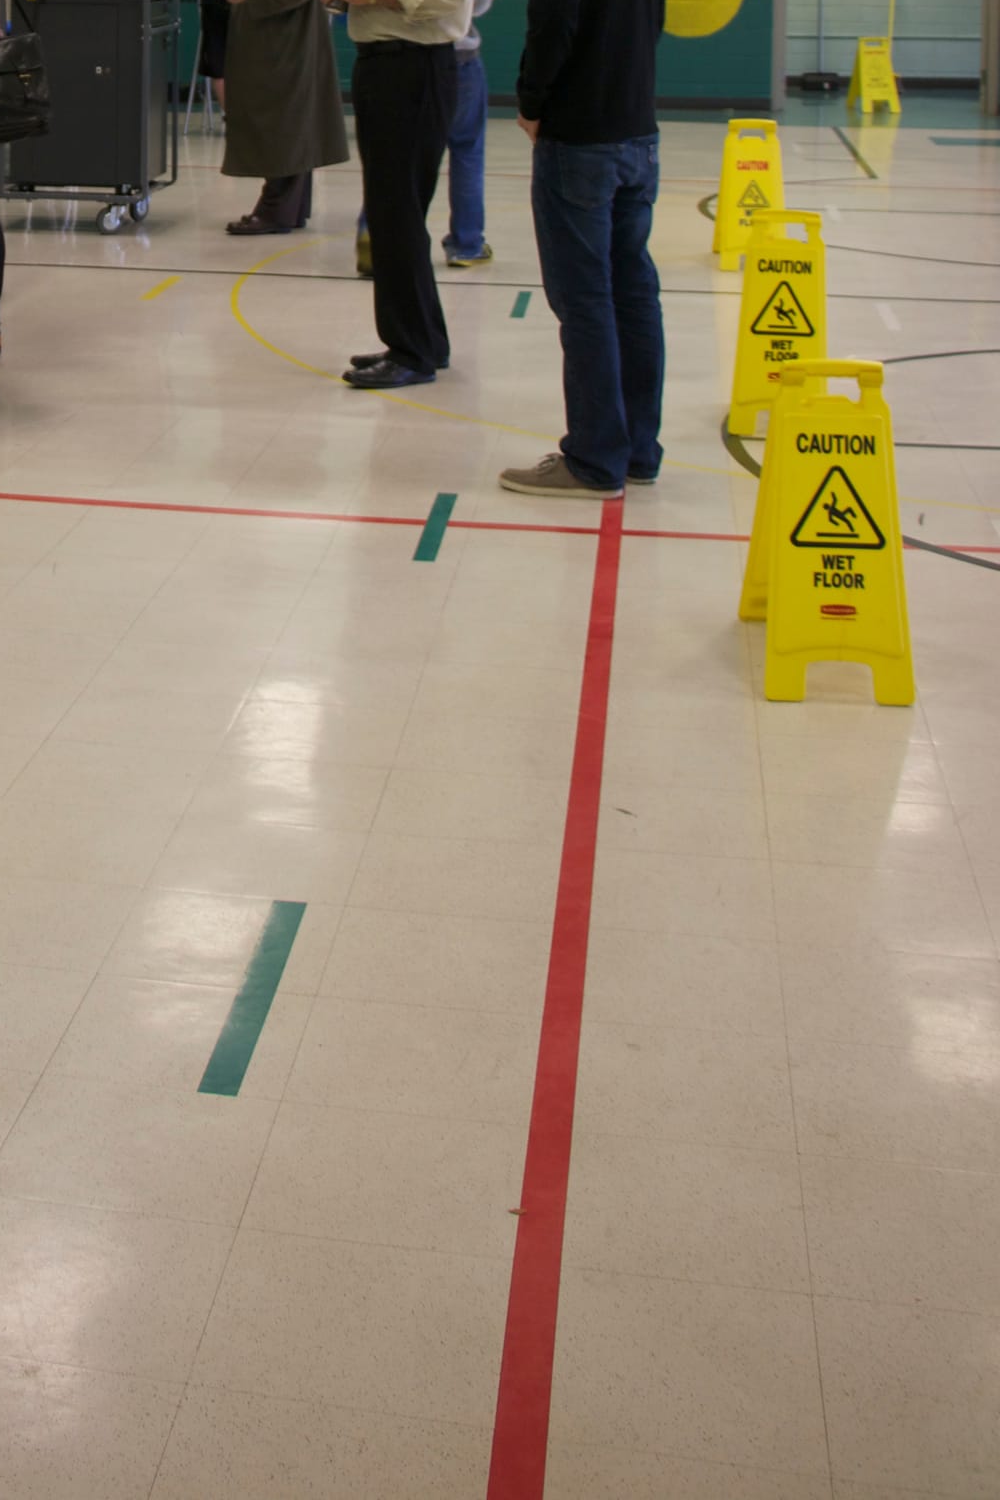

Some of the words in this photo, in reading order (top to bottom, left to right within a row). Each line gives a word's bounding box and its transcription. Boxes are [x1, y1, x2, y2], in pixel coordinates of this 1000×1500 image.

[737, 160, 769, 171] CAUTION
[758, 260, 812, 274] CAUTION
[771, 340, 793, 350] WET
[796, 433, 876, 455] CAUTION
[822, 555, 855, 571] WET
[813, 572, 865, 589] FLOOR
